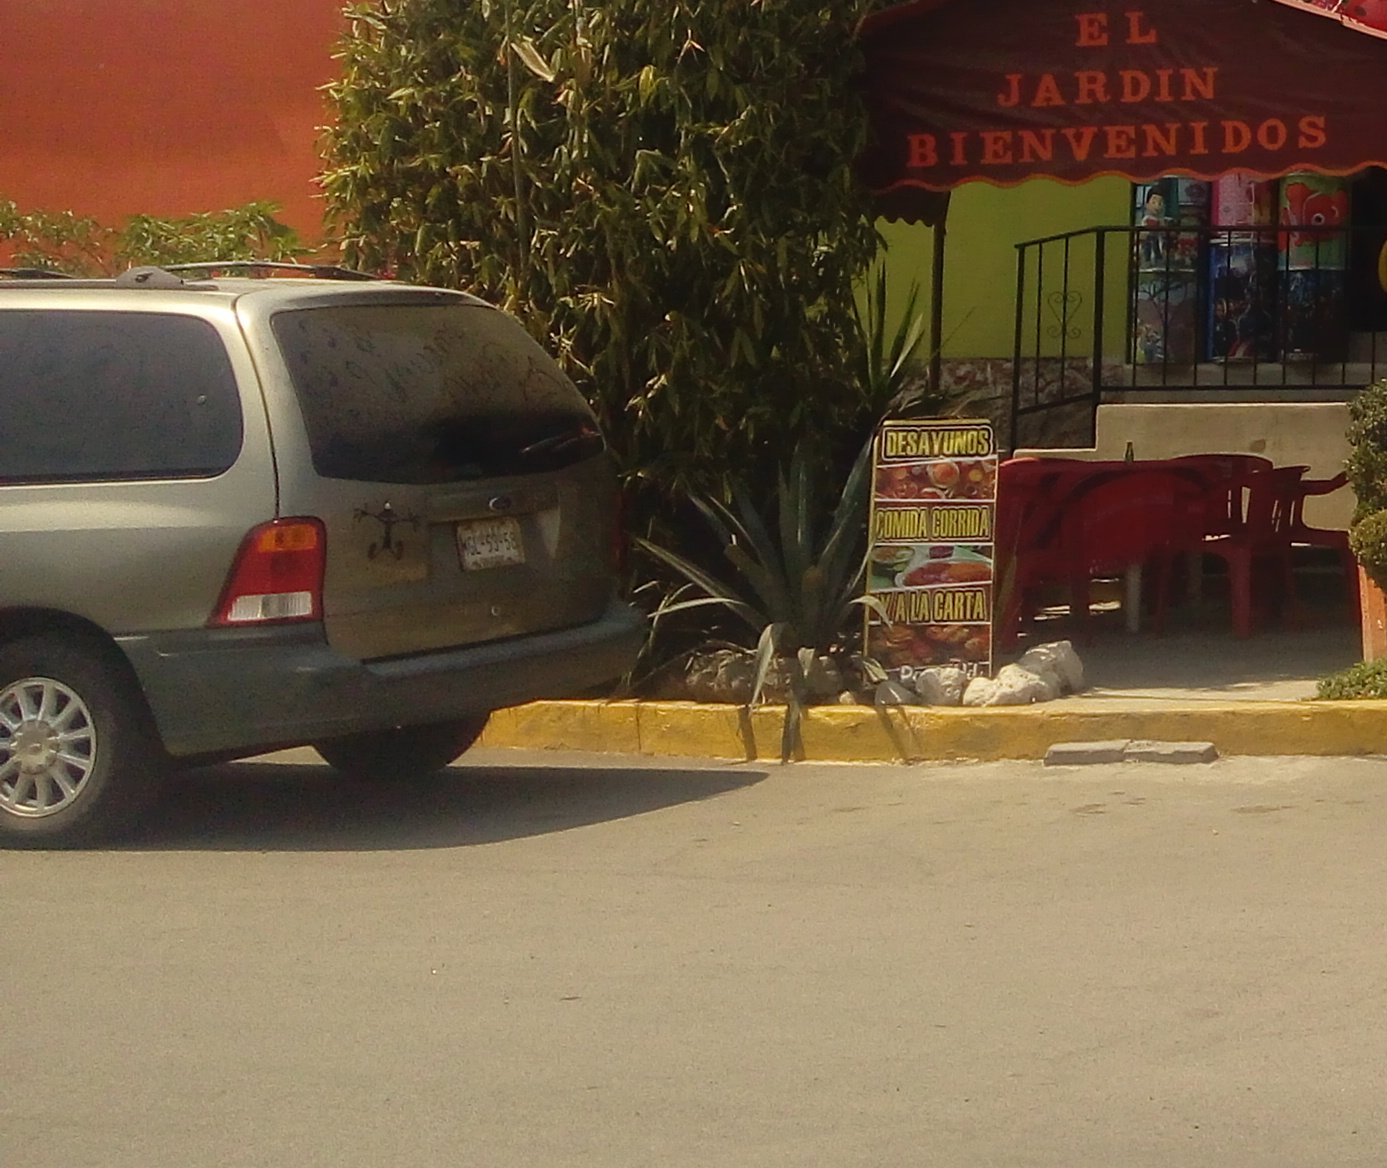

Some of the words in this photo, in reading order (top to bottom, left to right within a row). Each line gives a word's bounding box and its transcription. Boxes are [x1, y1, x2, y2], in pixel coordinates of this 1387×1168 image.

[1075, 10, 1158, 47] EL
[998, 67, 1219, 108] JARDIN
[906, 115, 1327, 168] BIENVENIDOS
[885, 429, 991, 457] DESAYUNOS
[876, 509, 928, 539] COMIDA
[931, 508, 990, 538] CORRIDA
[895, 592, 906, 621] A
[910, 592, 930, 621] LA
[933, 591, 985, 621] CARTA
